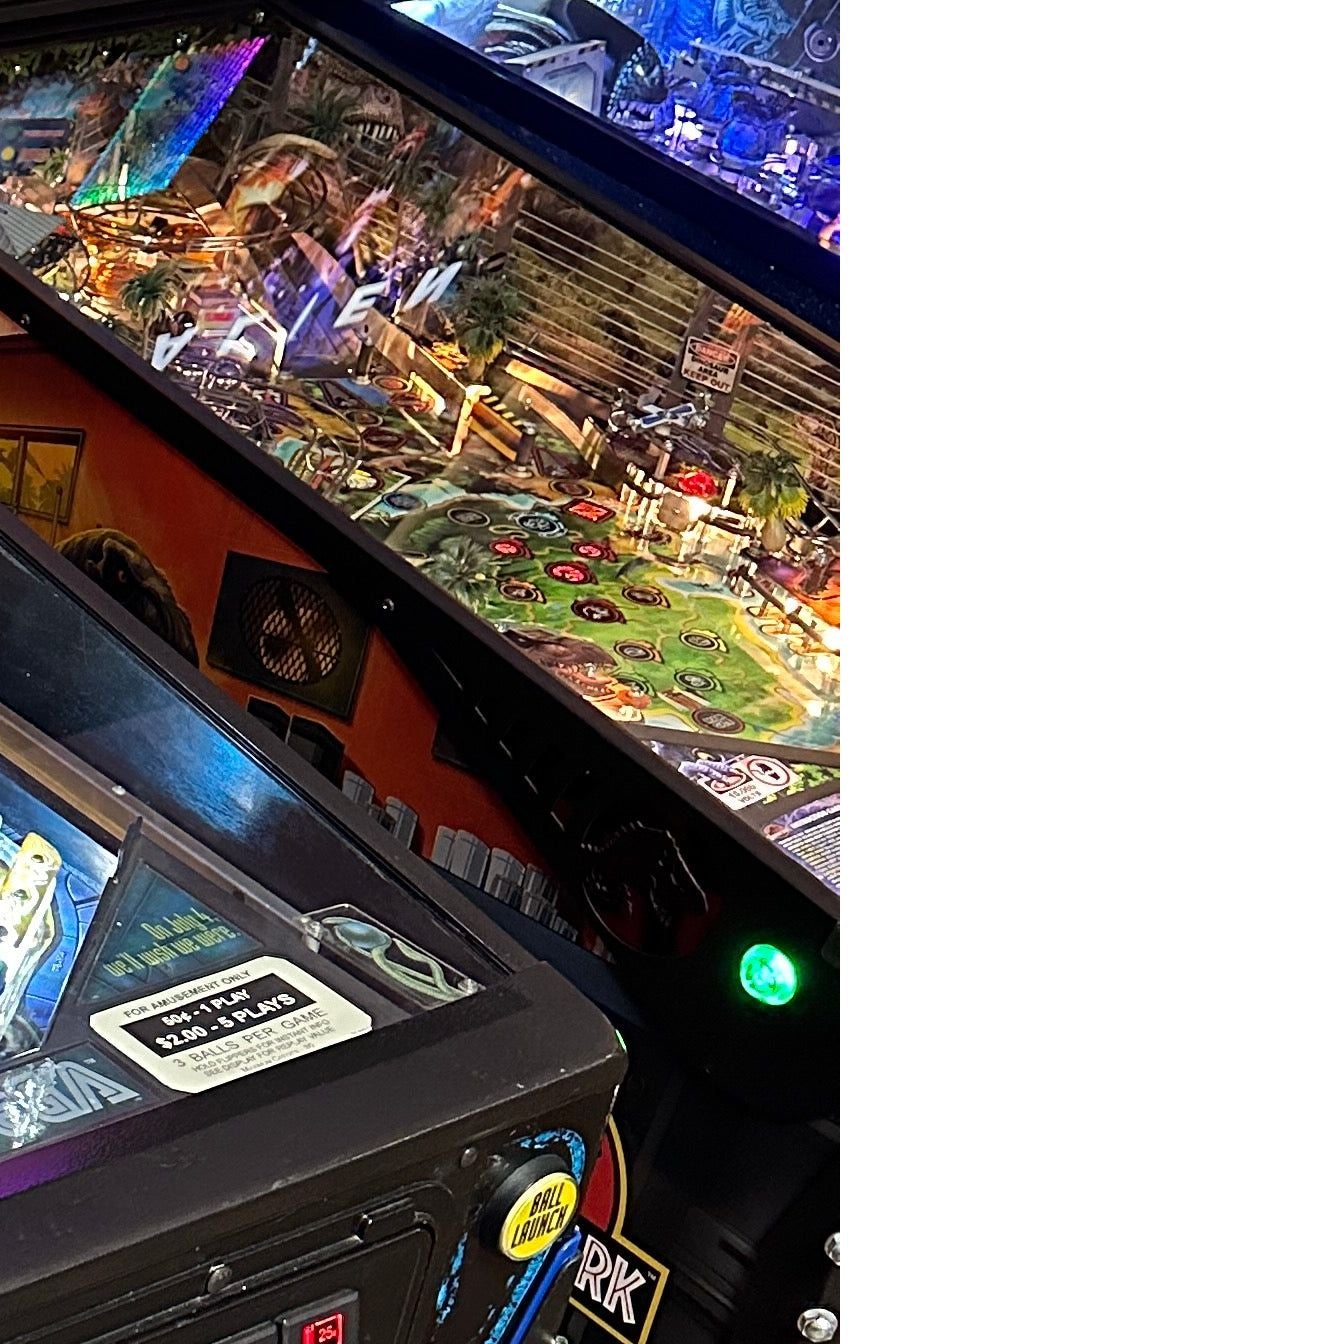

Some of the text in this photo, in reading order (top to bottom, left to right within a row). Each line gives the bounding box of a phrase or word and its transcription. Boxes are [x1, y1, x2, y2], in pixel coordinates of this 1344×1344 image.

[683, 368, 730, 391] KEEP OUT
[137, 941, 180, 966] wish
[171, 937, 201, 955] we
[140, 922, 175, 941] On
[122, 969, 254, 1018] FOR AMUSEMENT ONLY
[158, 1009, 196, 1028] 50¢
[196, 1003, 214, 1013] 1
[207, 988, 255, 1009] PLAY
[151, 1023, 211, 1050] $2.00
[213, 1015, 237, 1029] 5
[227, 992, 301, 1023] PLAYS
[170, 1057, 188, 1068] 3
[187, 1039, 241, 1062] BALLS
[240, 1026, 278, 1043] PER
[276, 1007, 330, 1030] GAME
[529, 1181, 565, 1218] BALL
[511, 1205, 569, 1249] LAUNCH
[574, 1233, 647, 1325] RK
